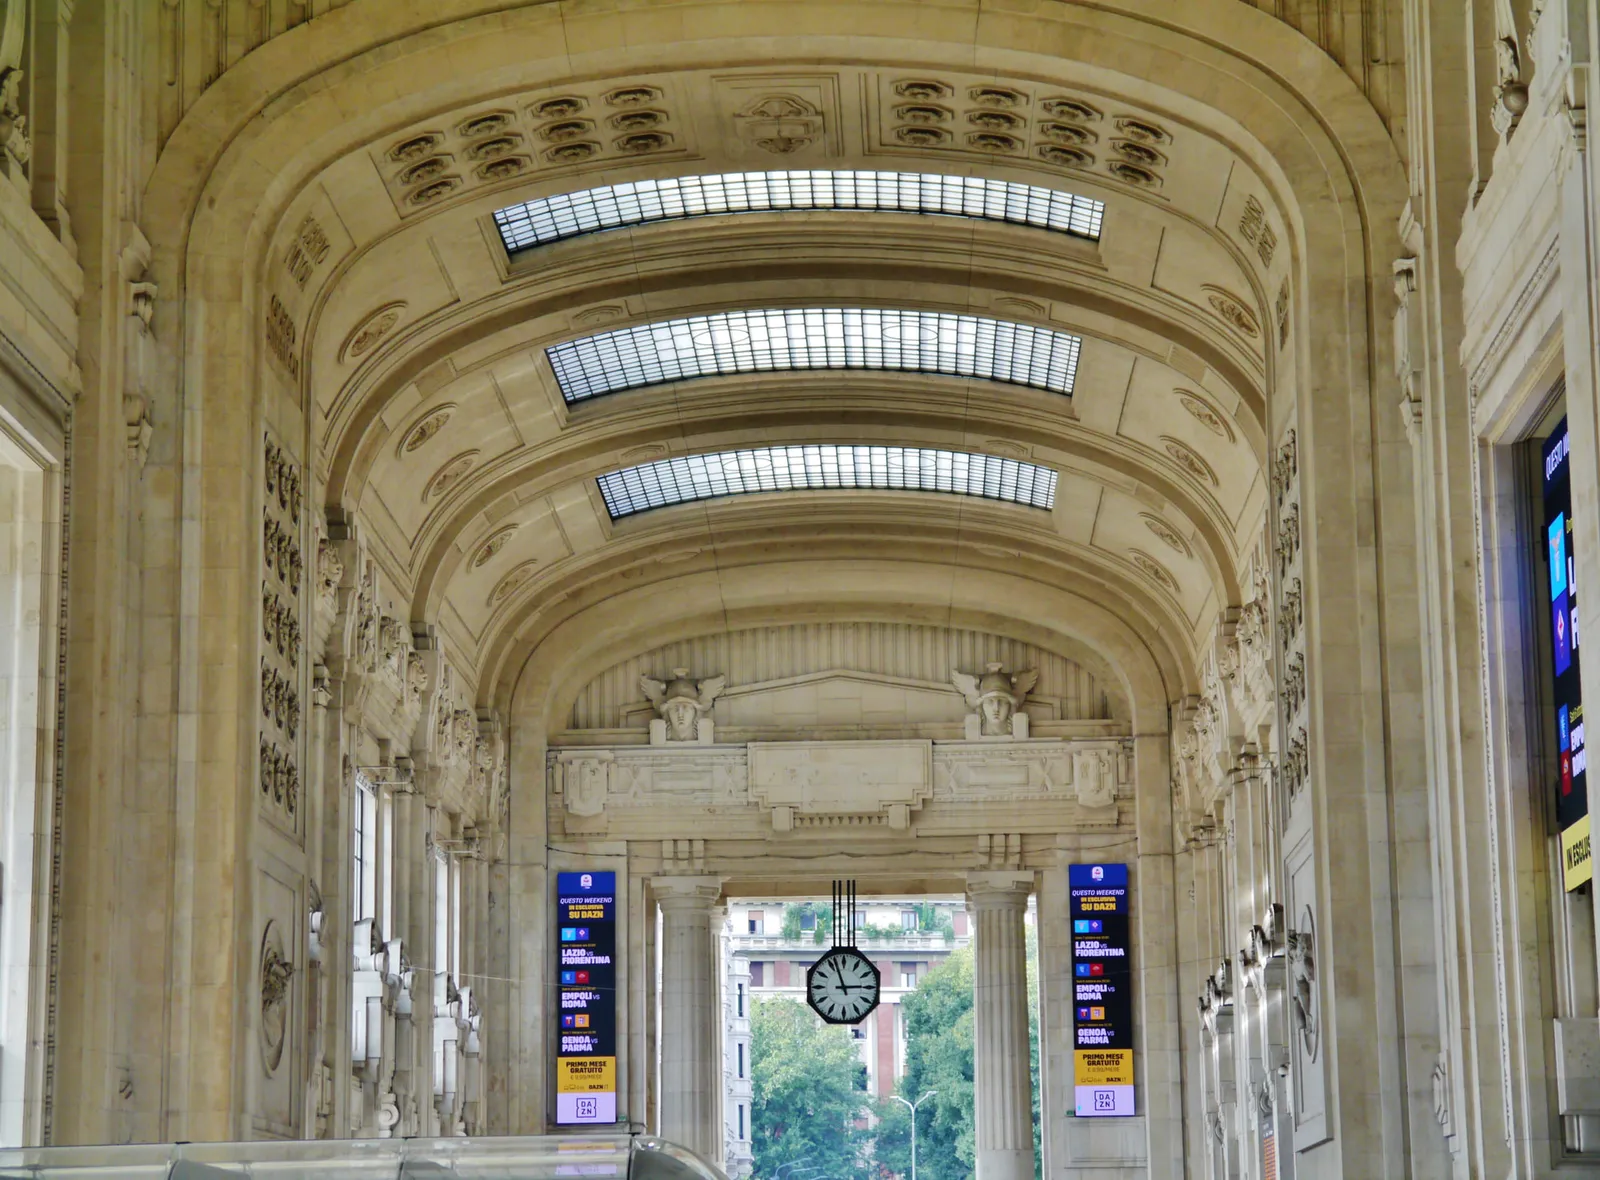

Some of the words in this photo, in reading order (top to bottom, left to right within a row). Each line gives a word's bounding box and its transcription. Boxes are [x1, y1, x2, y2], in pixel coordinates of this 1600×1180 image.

[1546, 440, 1563, 480] QUESTO
[1566, 846, 1573, 870] IN
[1081, 903, 1093, 911] SU
[1094, 903, 1116, 911] DAZN
[569, 911, 580, 919] SU
[581, 911, 604, 919] DAZN
[1075, 941, 1100, 949] LAZIO
[562, 948, 586, 957] LAZIO
[1075, 948, 1125, 957] FIORENTINA
[562, 956, 611, 965] FIORENTINA
[1076, 984, 1107, 992] EMPOLI
[562, 992, 593, 1000] EMPOLI
[1077, 992, 1102, 1000] ROMA
[562, 1000, 587, 1008] ROMA
[1078, 1028, 1107, 1036] GENOA
[562, 1035, 591, 1044] GENOA
[1078, 1036, 1109, 1044] PARMA
[562, 1043, 593, 1052] PARMA
